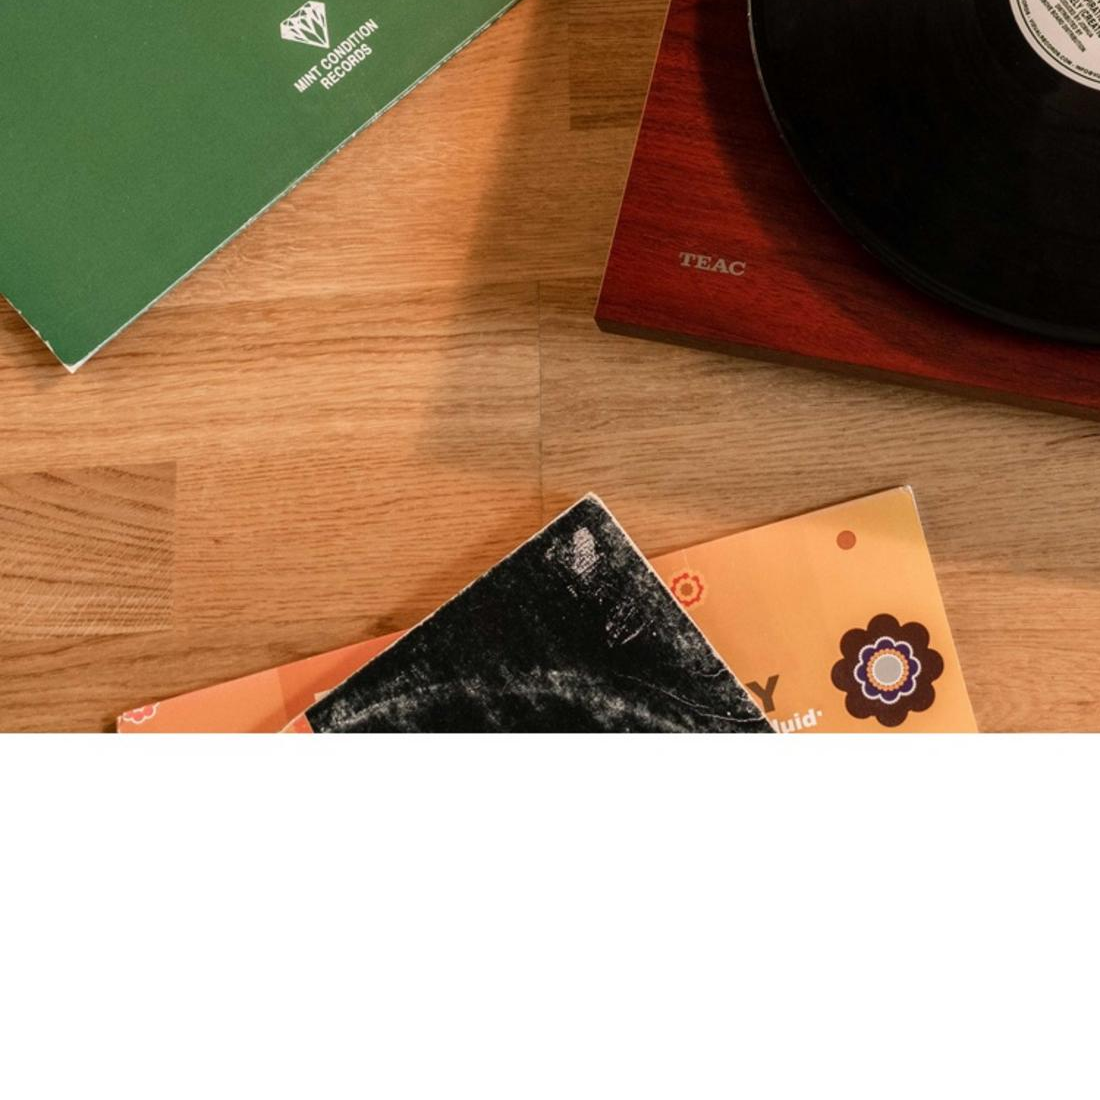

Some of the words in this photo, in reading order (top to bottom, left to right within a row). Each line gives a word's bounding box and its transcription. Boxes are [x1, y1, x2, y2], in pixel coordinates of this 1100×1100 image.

[293, 65, 322, 93] MINT
[320, 18, 379, 70] CONDITION
[320, 43, 372, 90] RECORDS
[679, 252, 746, 276] TEAC
